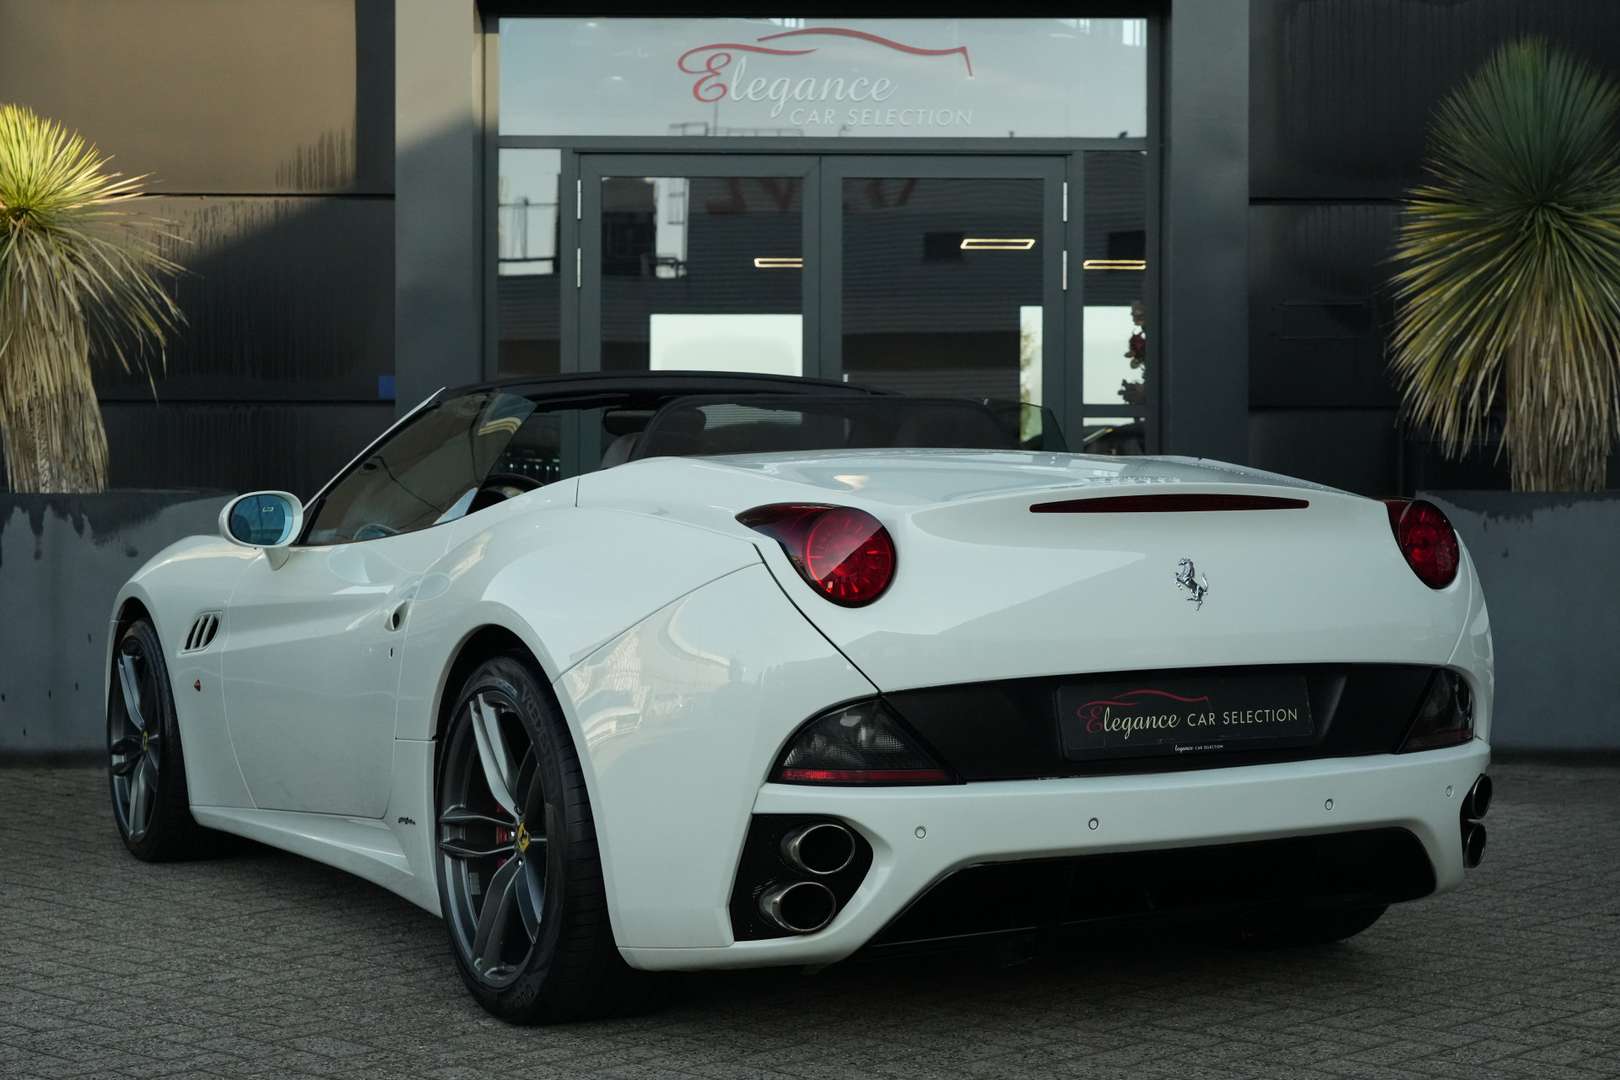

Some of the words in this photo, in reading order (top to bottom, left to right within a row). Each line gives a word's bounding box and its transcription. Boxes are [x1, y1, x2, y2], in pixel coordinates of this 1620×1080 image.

[678, 43, 897, 118] Elegance
[790, 108, 835, 126] CAR
[847, 108, 973, 126] SELECTION
[1076, 700, 1182, 740] Elegance
[1187, 712, 1216, 727] CAR
[1223, 708, 1298, 725] SELECTION
